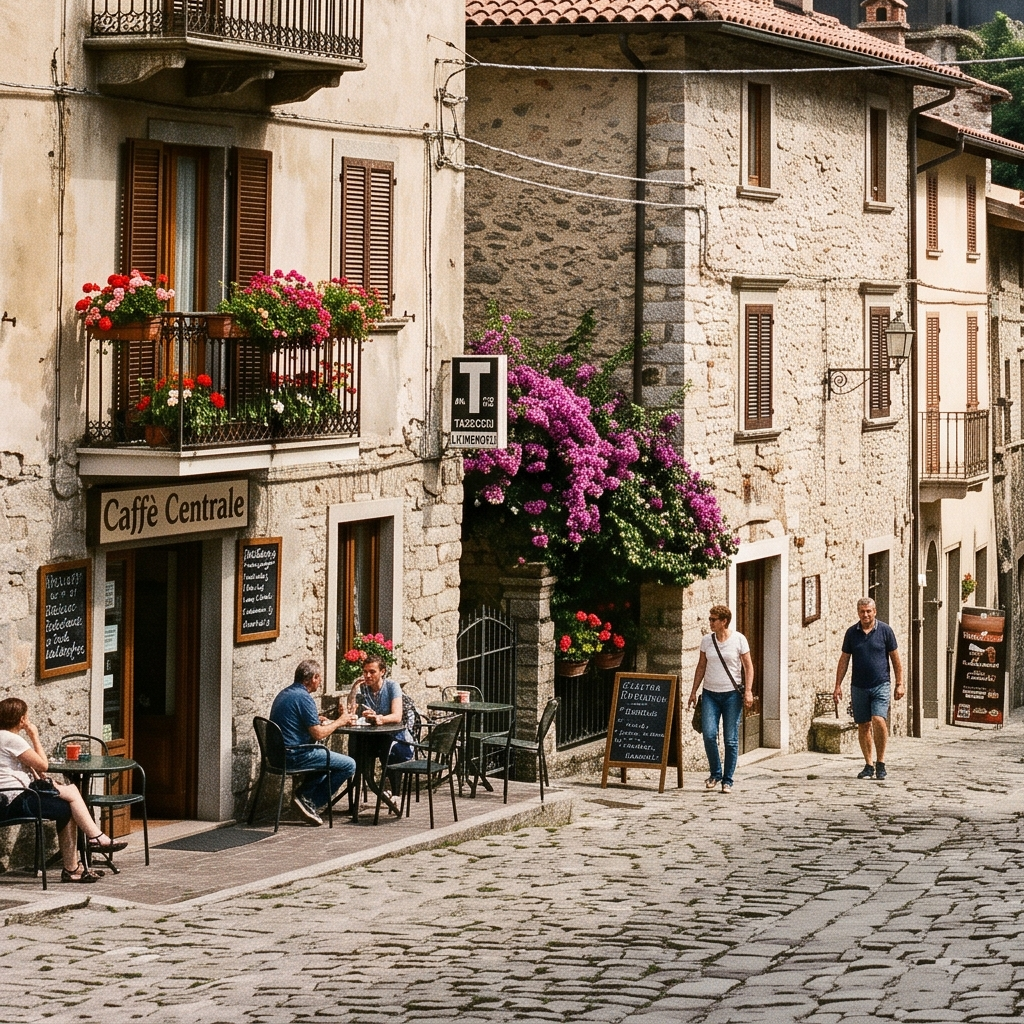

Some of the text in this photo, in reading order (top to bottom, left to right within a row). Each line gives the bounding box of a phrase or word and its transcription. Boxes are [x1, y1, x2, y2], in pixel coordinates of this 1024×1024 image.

[459, 361, 491, 414] T
[103, 486, 245, 535] Caffè Centrale
